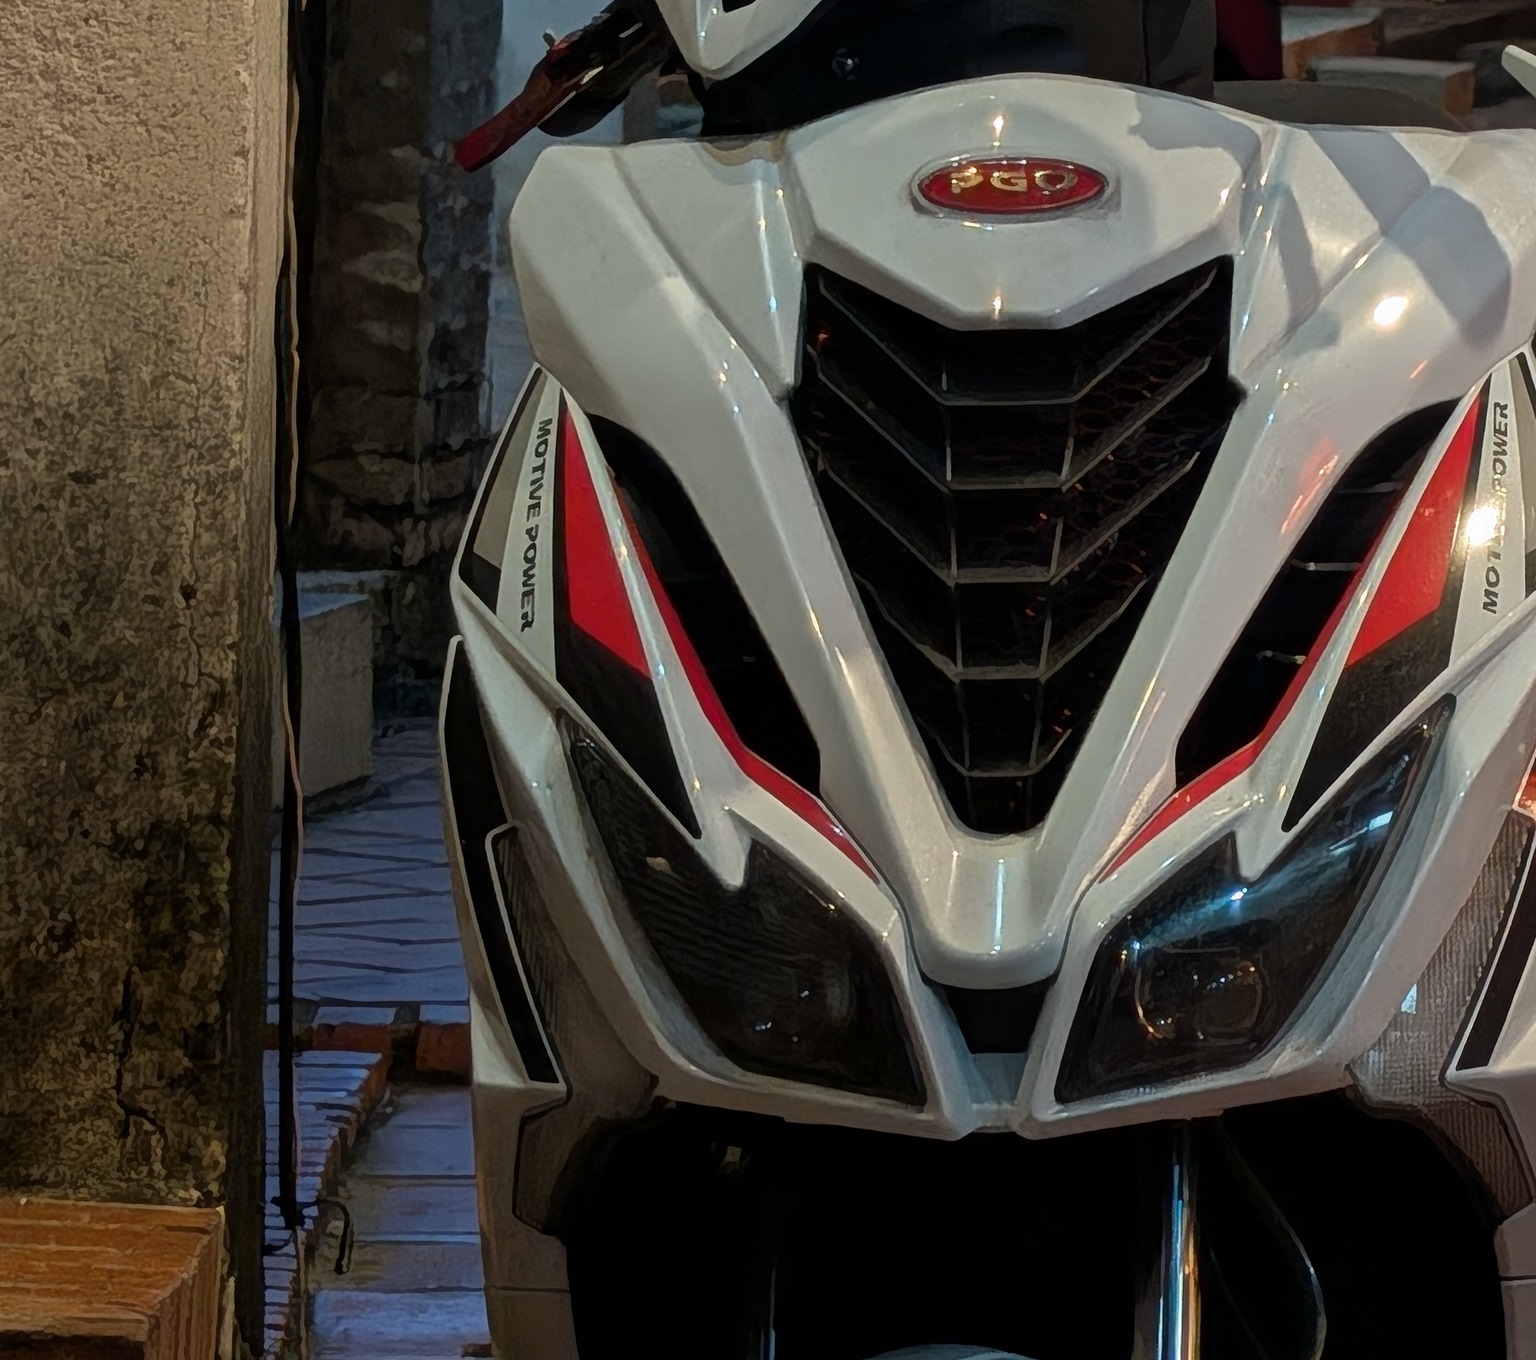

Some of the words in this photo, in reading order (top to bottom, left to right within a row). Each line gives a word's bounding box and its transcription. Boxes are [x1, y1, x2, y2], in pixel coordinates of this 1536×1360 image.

[525, 417, 553, 523] MOTIVE
[520, 524, 540, 633] POWER
[1482, 499, 1506, 615] MOT
